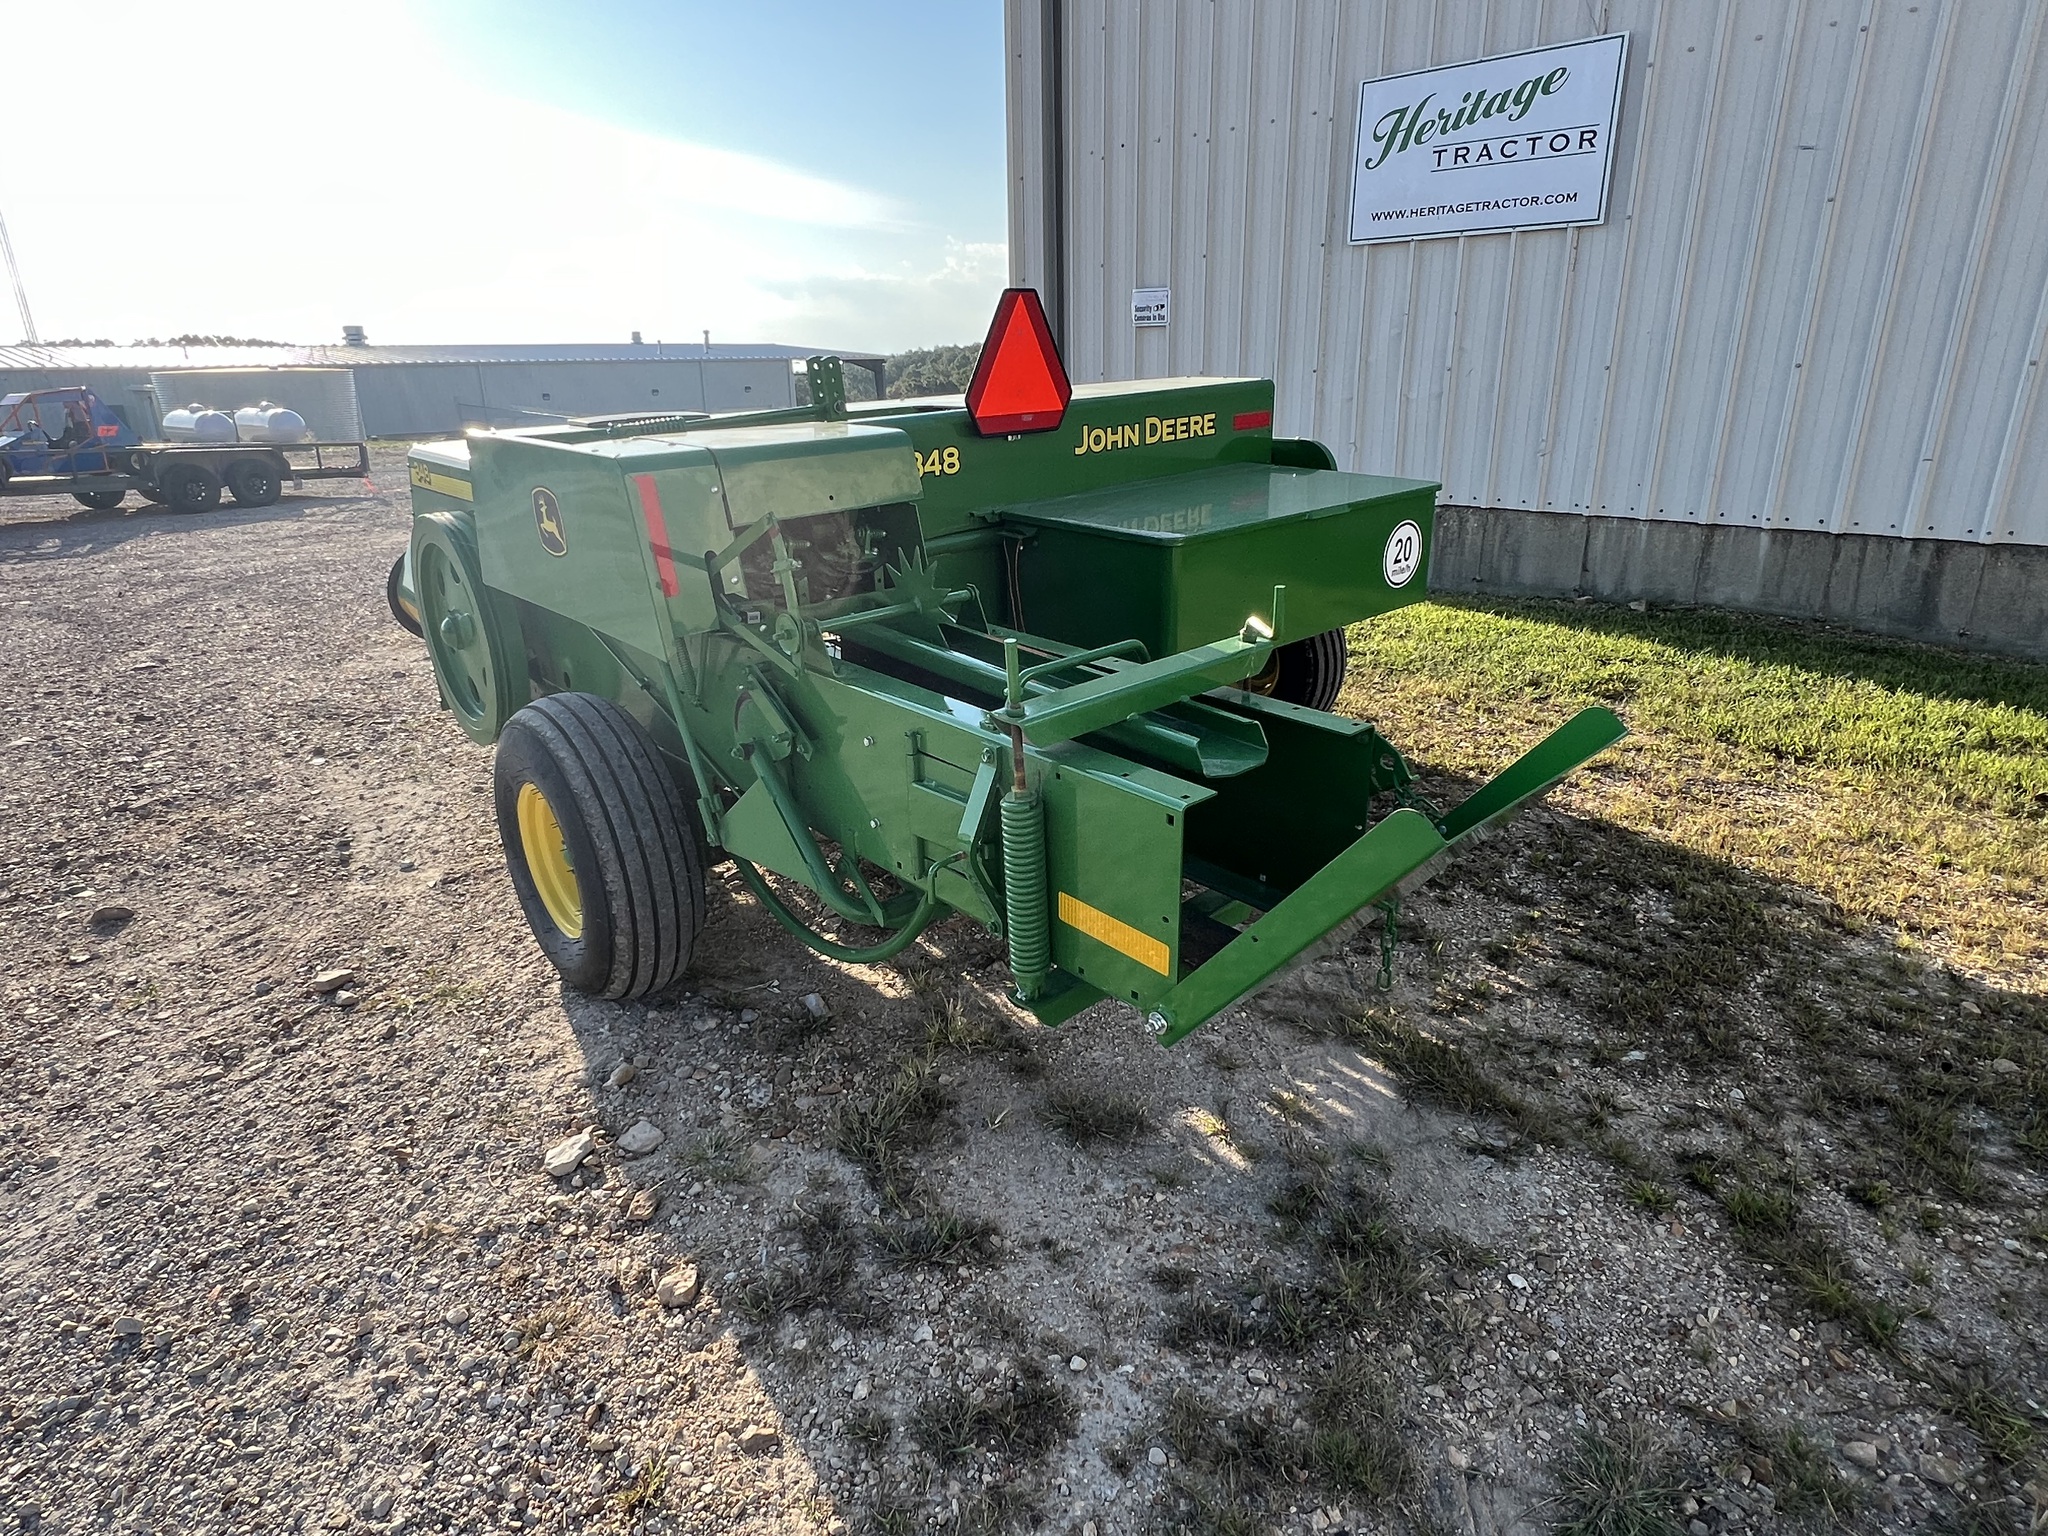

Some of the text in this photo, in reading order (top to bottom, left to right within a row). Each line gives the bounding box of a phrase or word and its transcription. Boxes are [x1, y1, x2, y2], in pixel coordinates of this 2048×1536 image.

[1365, 66, 1571, 170] Heritage
[1433, 129, 1598, 167] TRACTOR
[1370, 192, 1578, 222] WWW.HERITAGETRACTOR.COM
[1074, 412, 1217, 456] JOHN DEERE
[1393, 536, 1413, 565] 20
